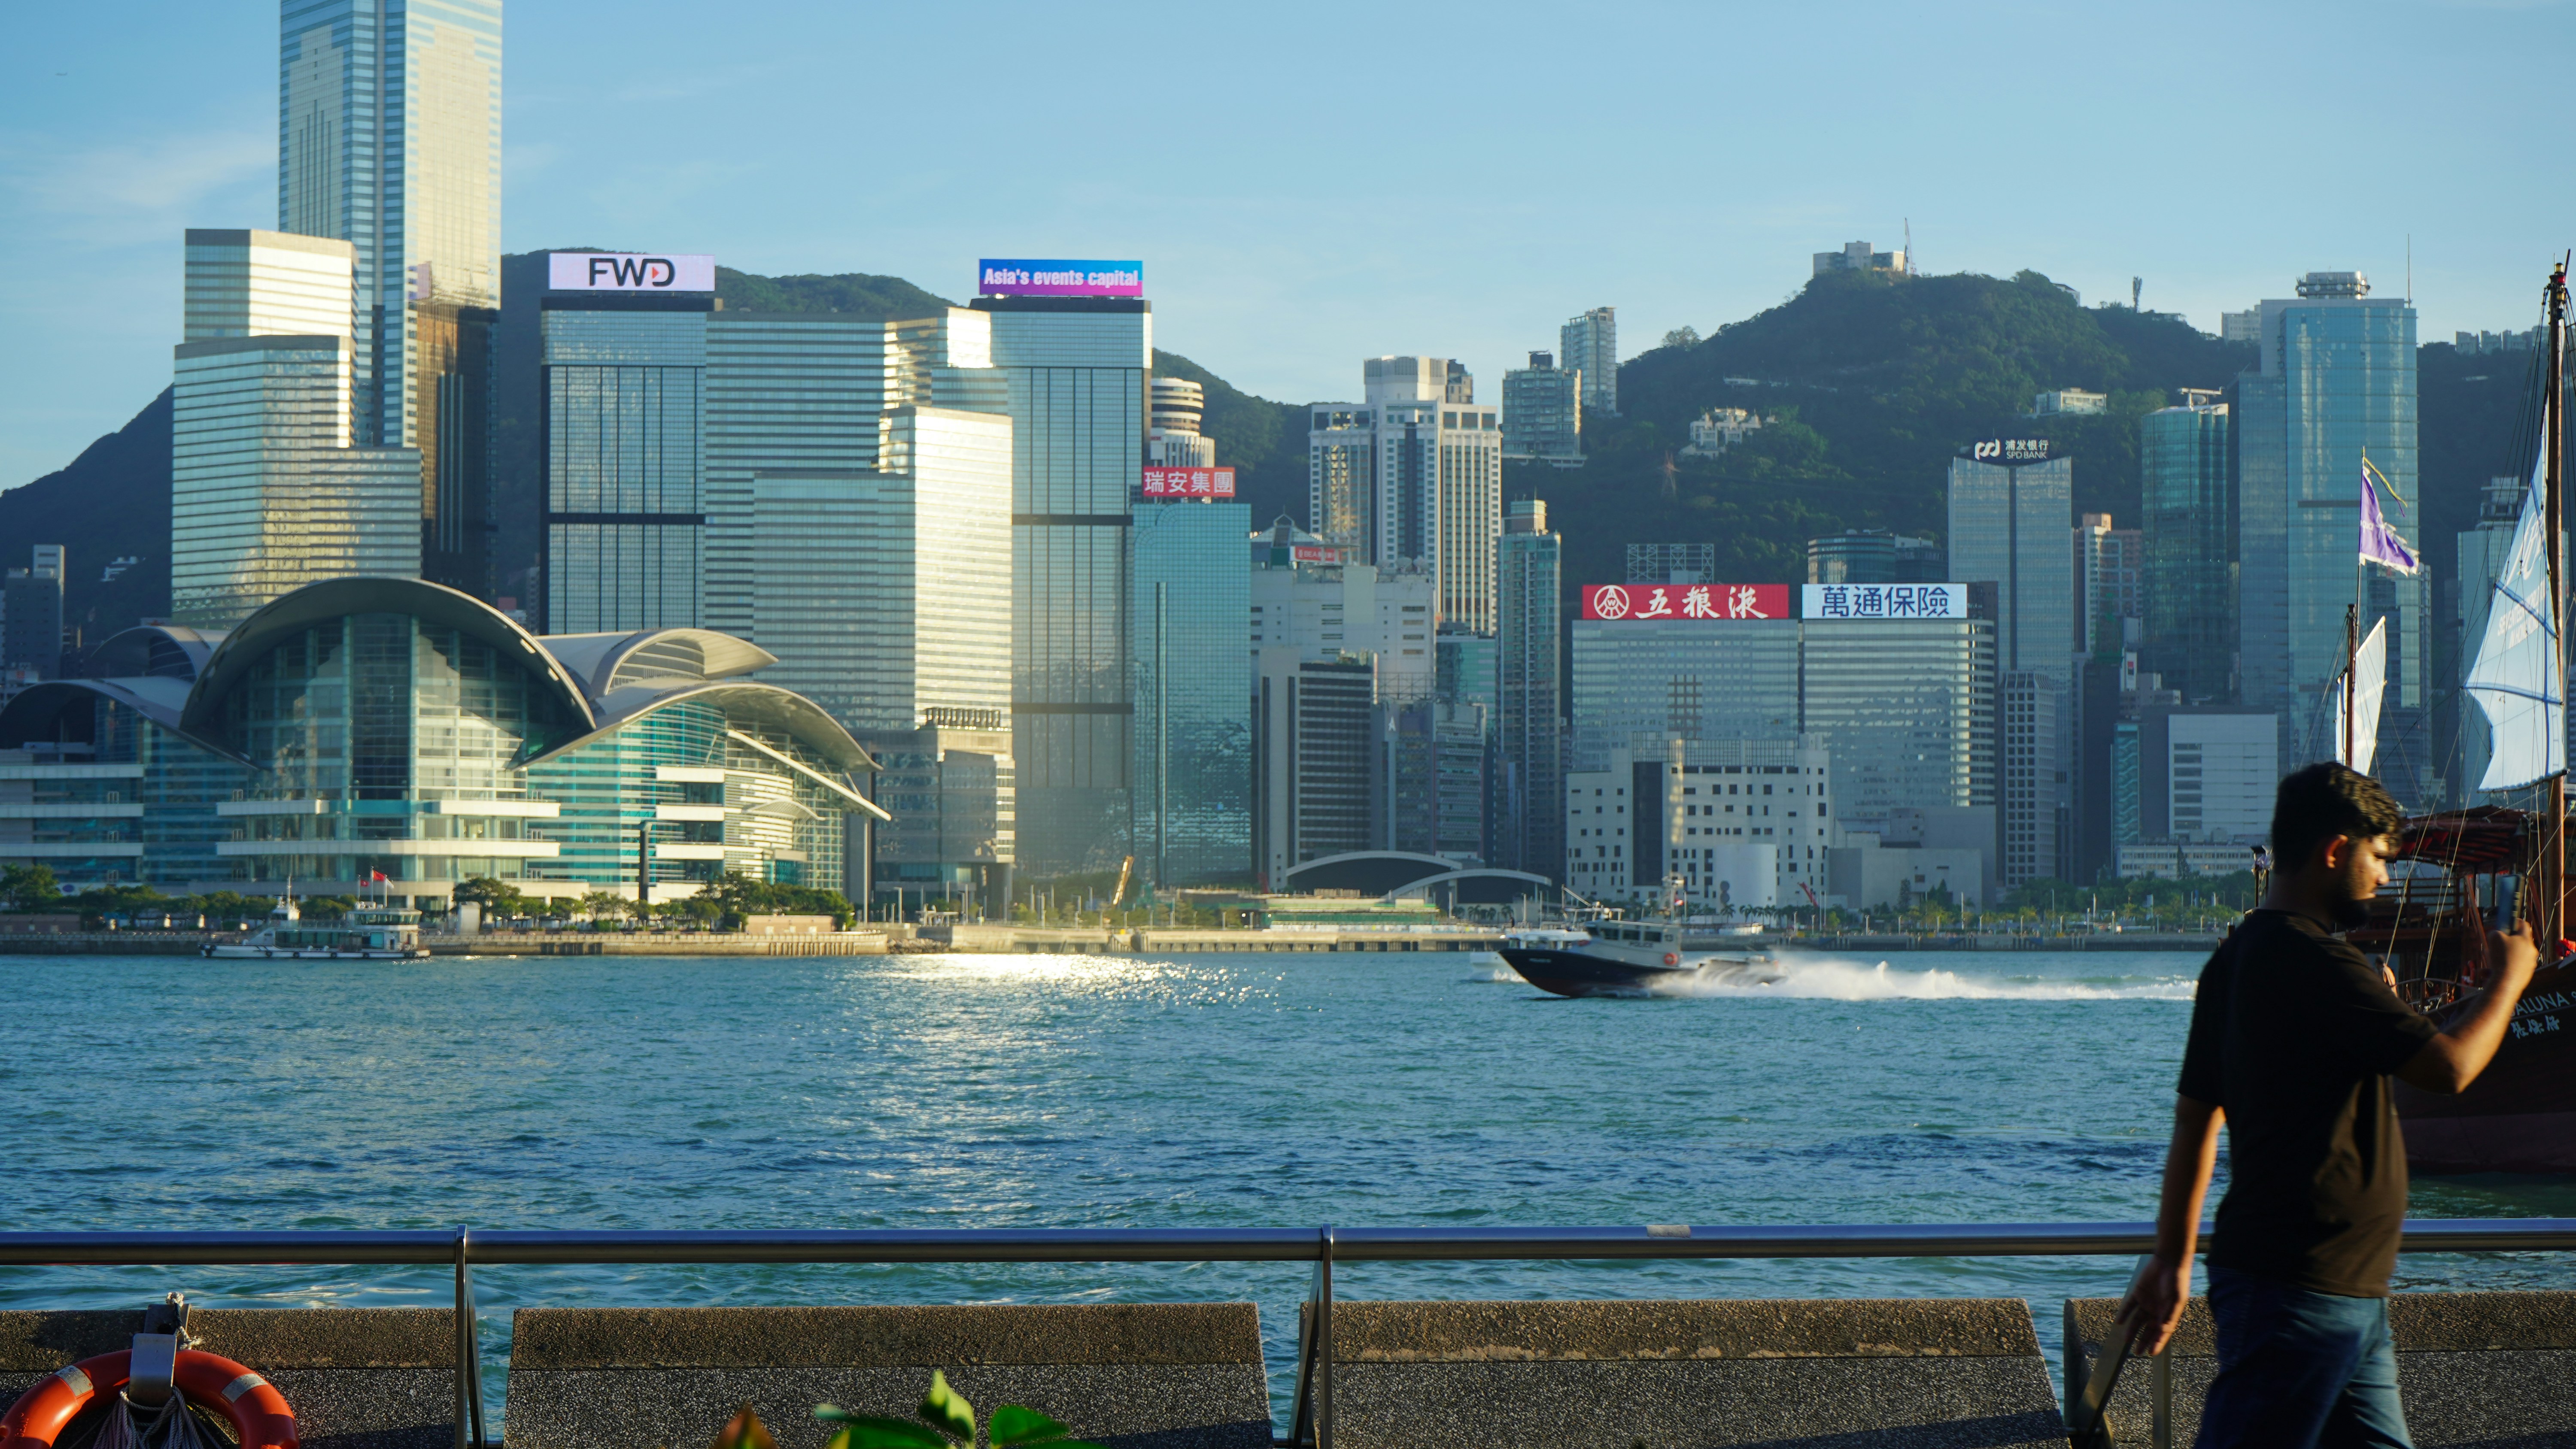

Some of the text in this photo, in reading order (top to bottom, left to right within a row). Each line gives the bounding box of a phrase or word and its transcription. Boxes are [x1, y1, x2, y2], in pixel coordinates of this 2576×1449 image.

[589, 258, 675, 286] FWD
[984, 268, 1138, 288] Asia's events capital
[2005, 439, 2049, 451] 浦发银行
[2006, 451, 2047, 459] SPD BANK
[1144, 471, 1233, 493] 瑞安集團
[1822, 586, 1950, 616] 萬通保險
